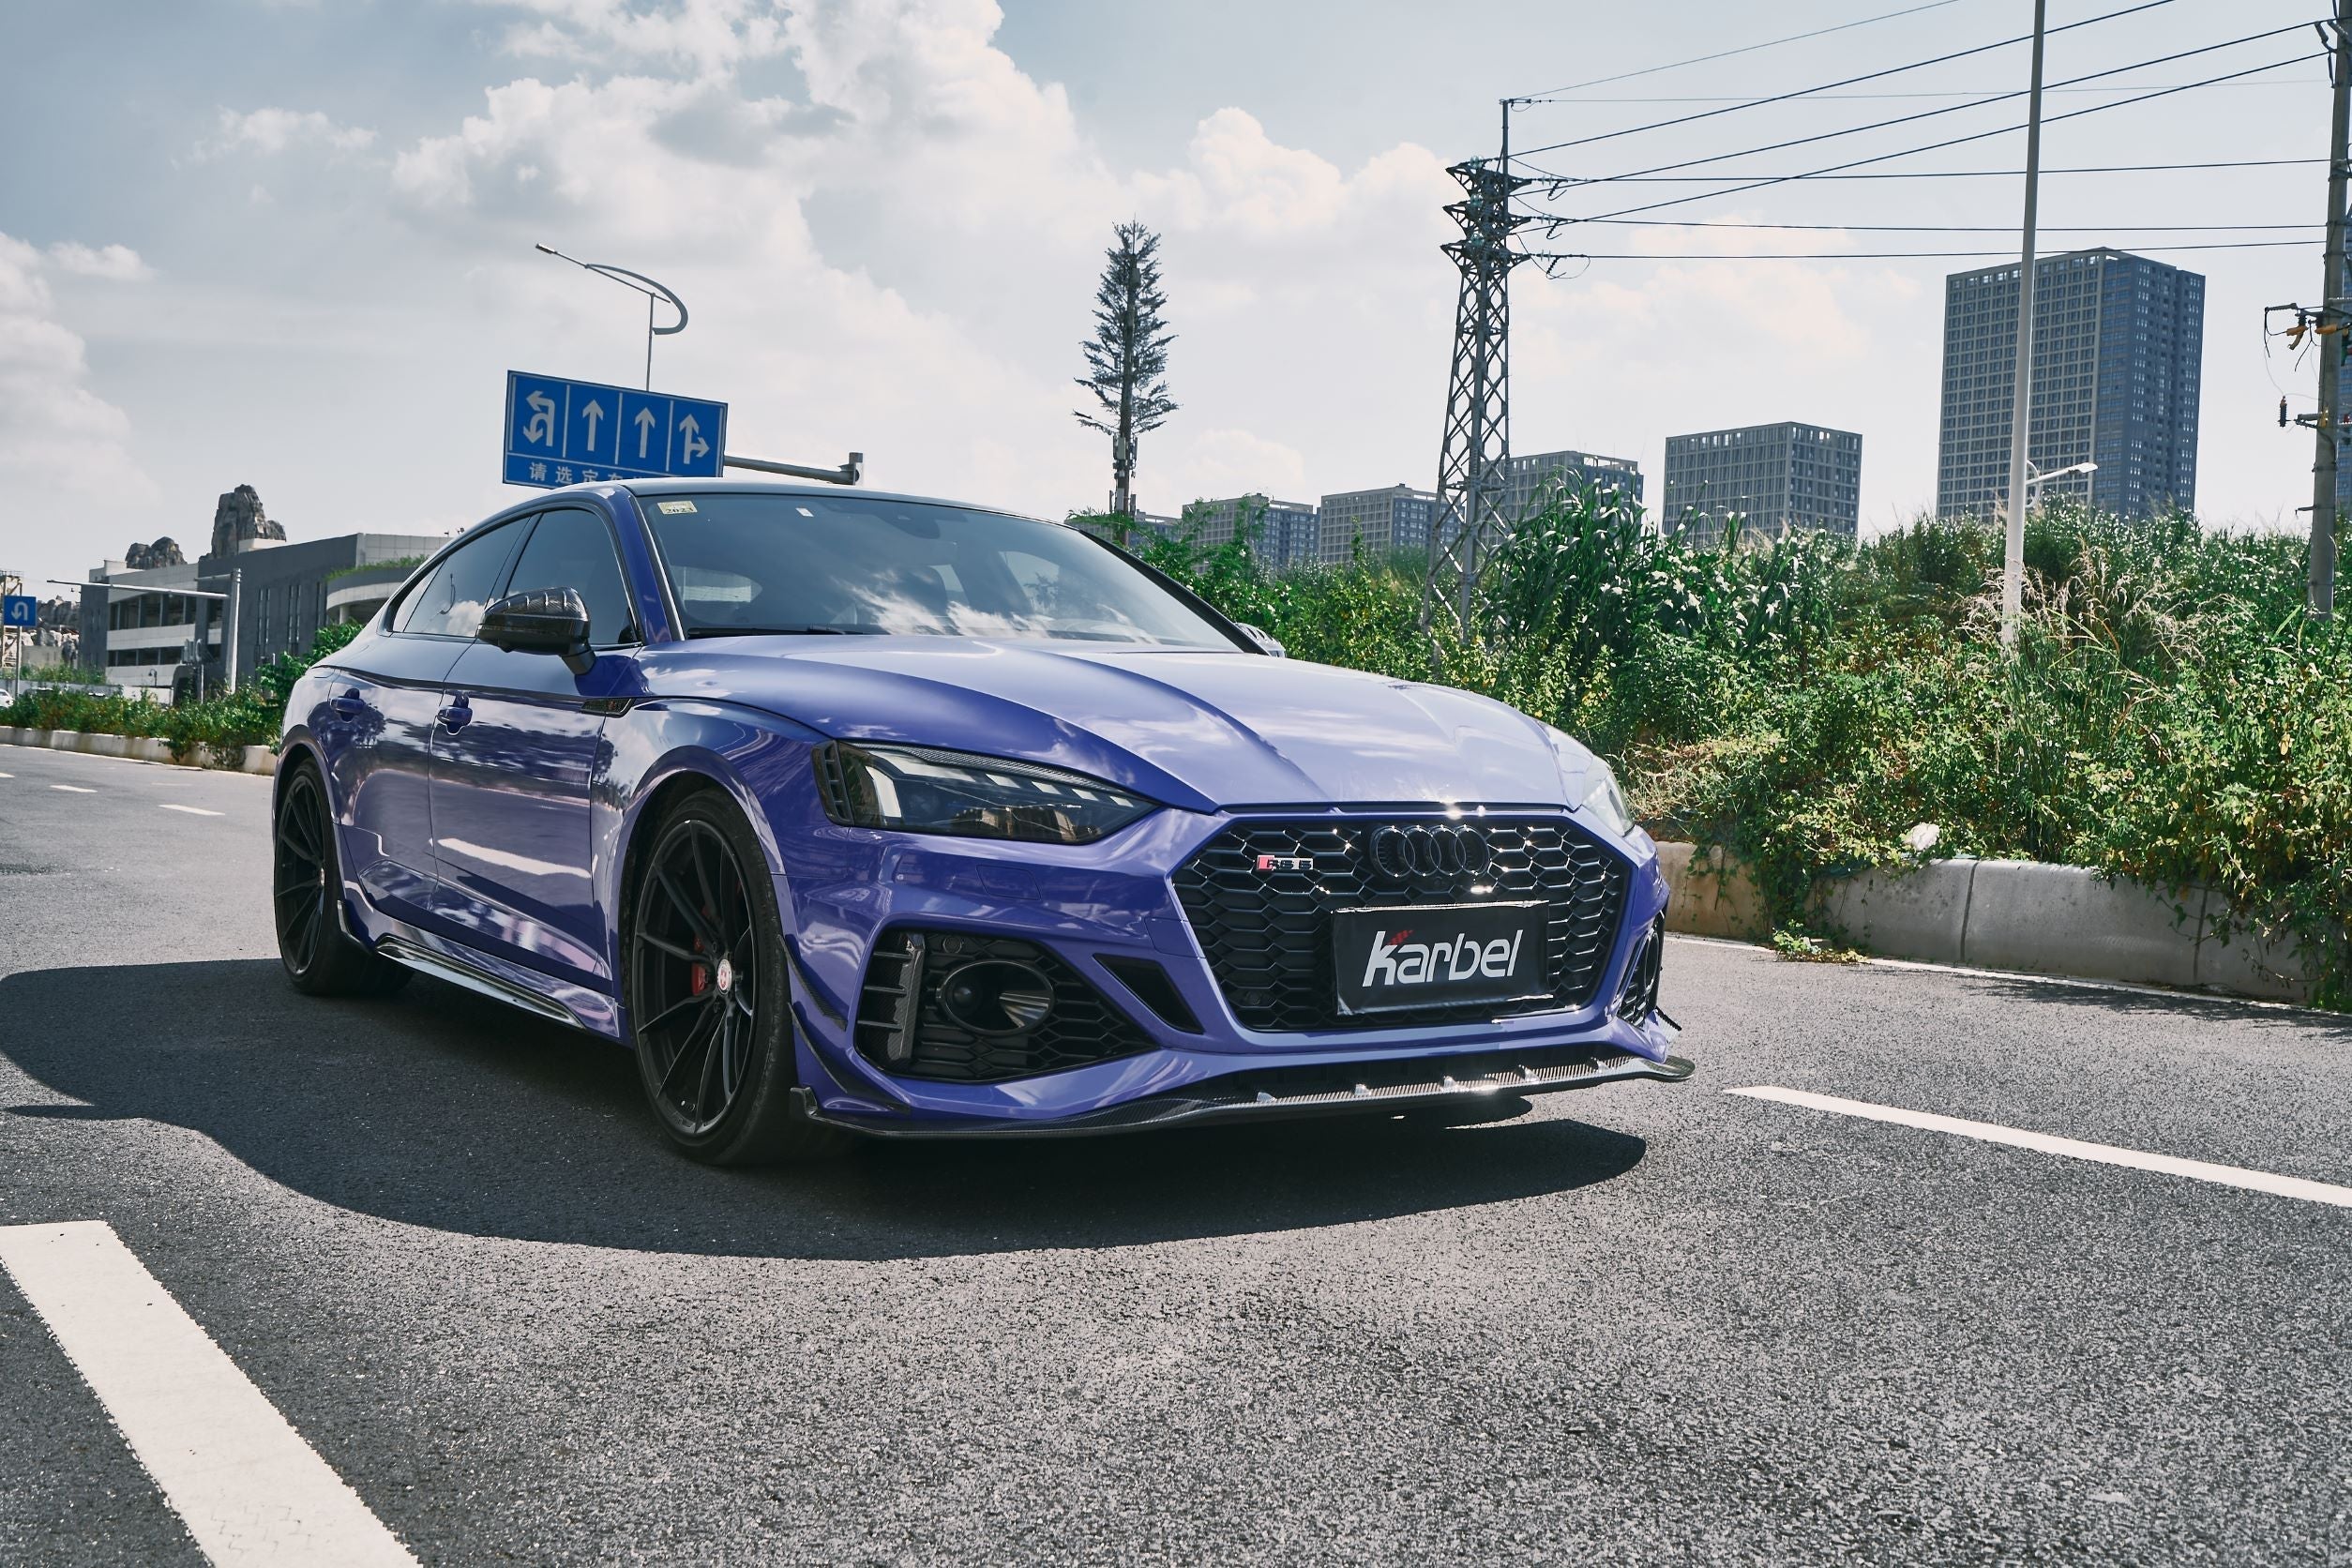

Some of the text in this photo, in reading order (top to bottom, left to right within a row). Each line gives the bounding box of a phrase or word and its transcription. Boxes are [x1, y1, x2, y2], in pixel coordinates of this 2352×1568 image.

[529, 462, 642, 484] 请选定
[1362, 929, 1524, 988] karbel
